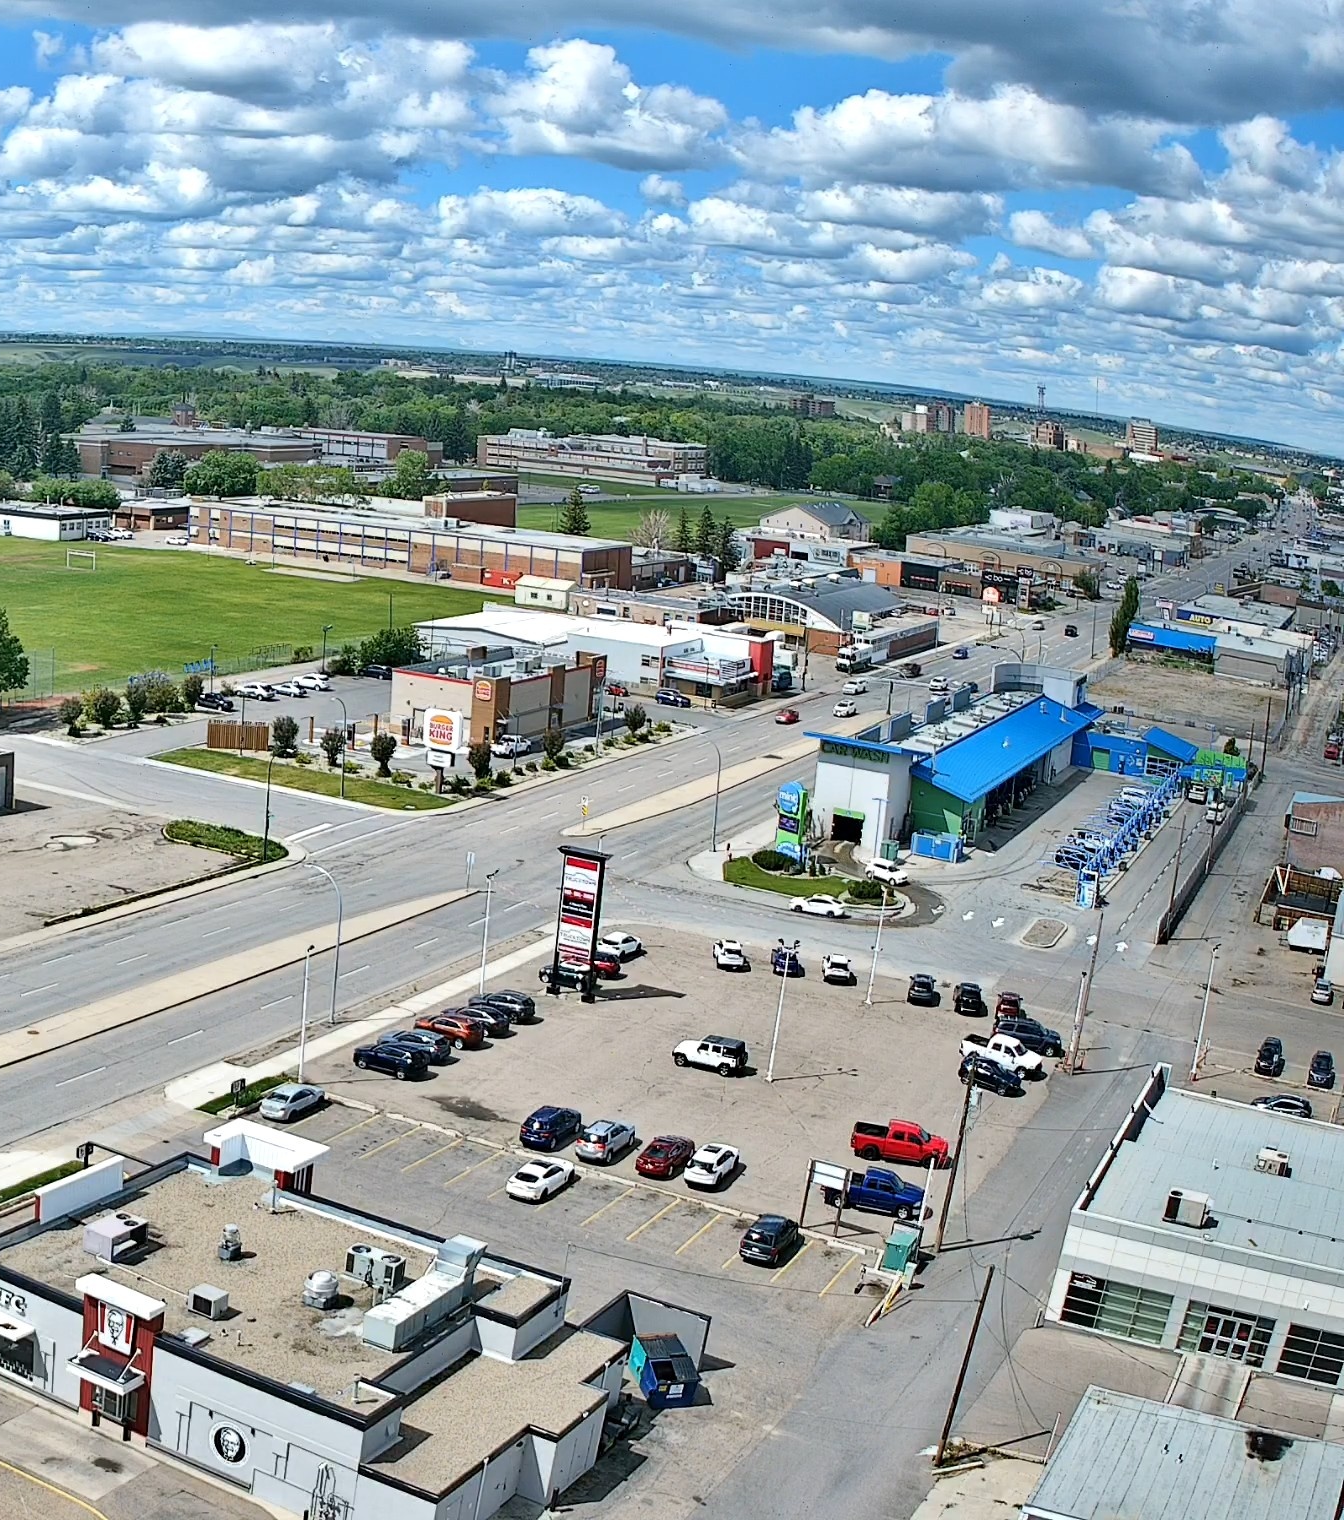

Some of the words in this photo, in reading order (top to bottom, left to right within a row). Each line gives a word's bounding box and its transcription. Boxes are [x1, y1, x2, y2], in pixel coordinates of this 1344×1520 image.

[1189, 613, 1212, 624] AUTO
[430, 722, 453, 732] BURGER
[429, 729, 453, 740] KING
[820, 742, 847, 756] CAR
[852, 746, 890, 764] WASH
